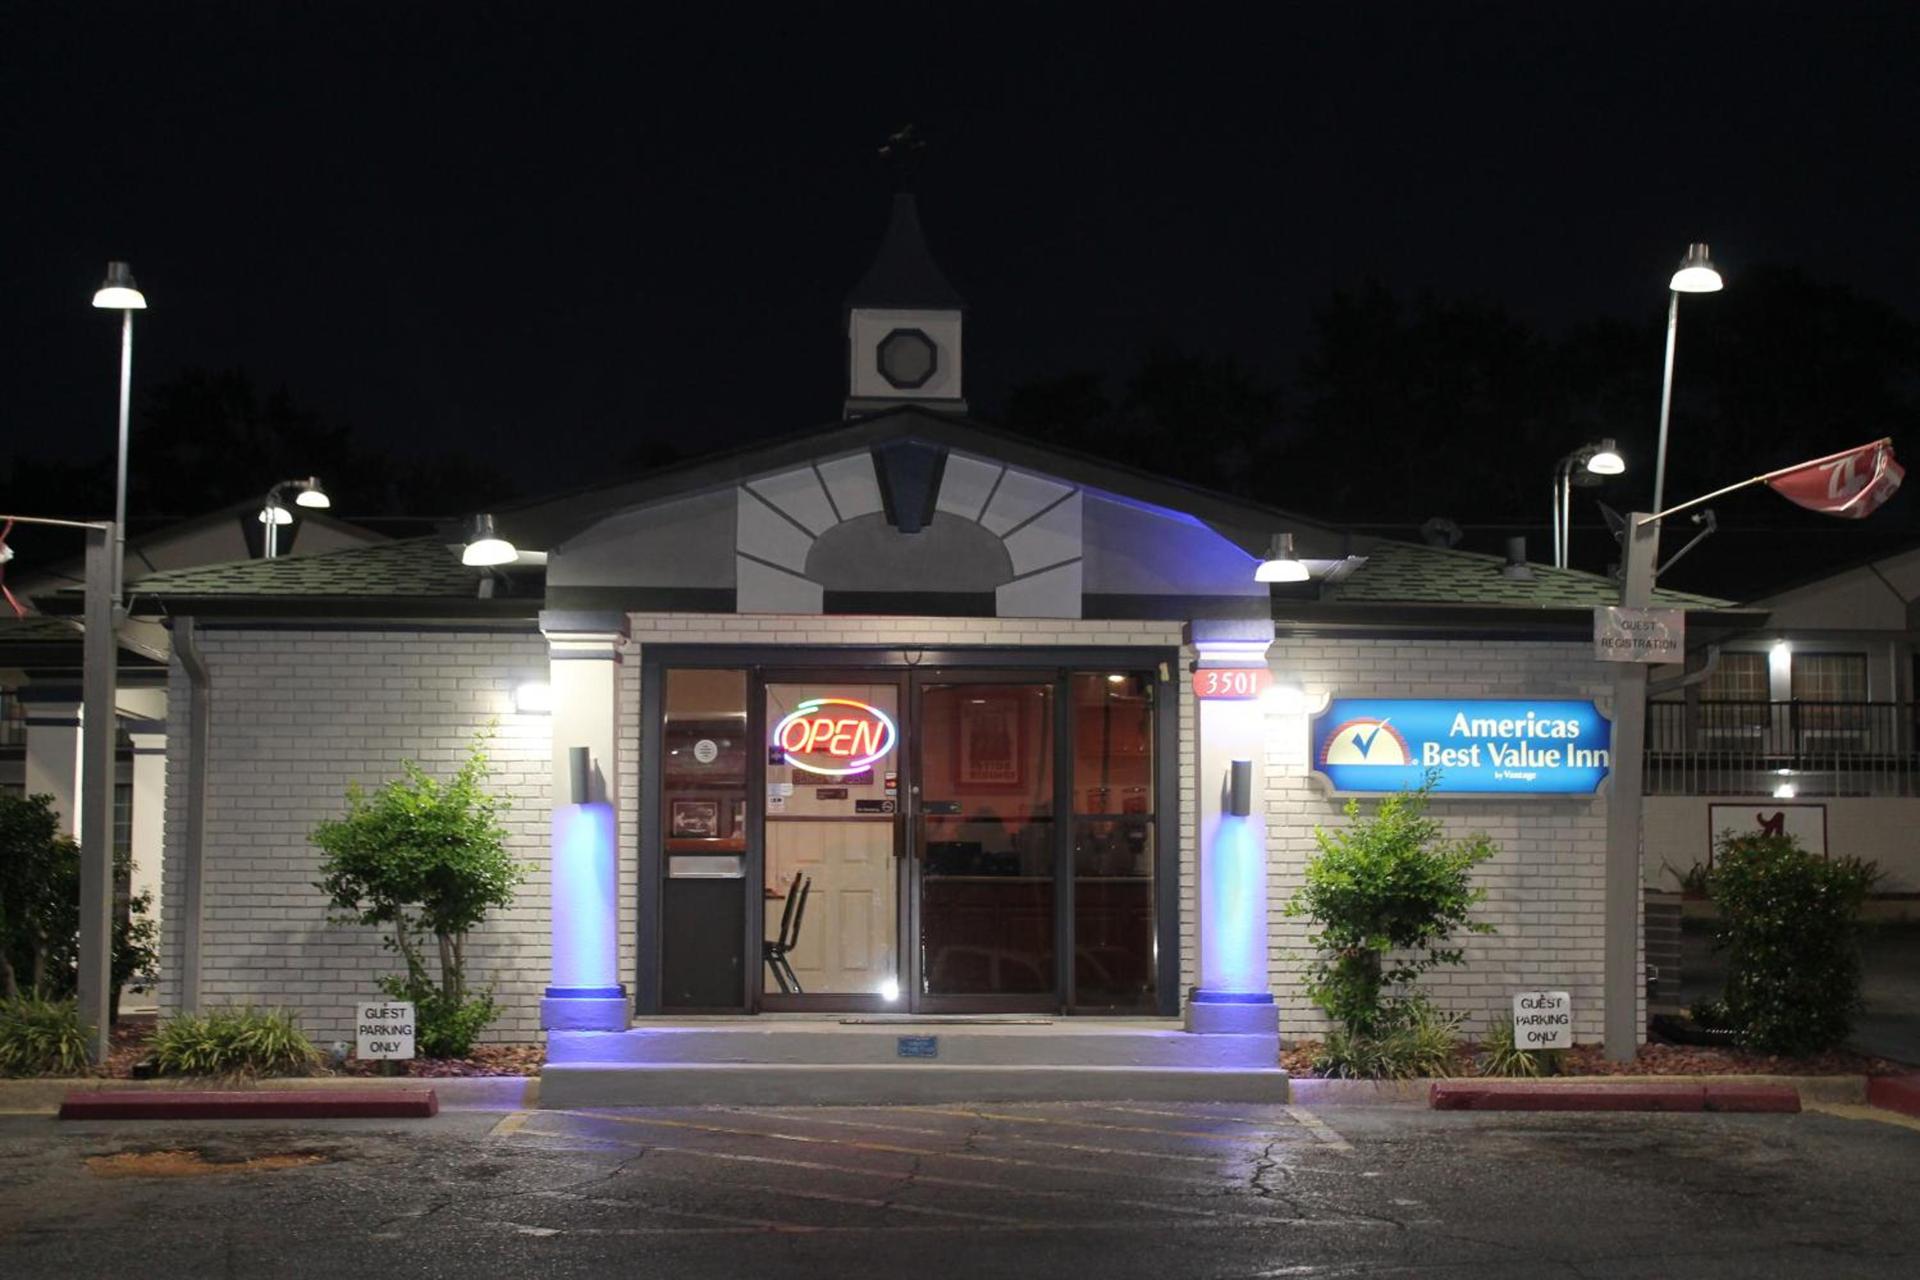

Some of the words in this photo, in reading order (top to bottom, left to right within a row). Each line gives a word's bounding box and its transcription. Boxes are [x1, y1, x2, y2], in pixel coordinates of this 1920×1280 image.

[1621, 620, 1656, 631] GUEST
[1601, 638, 1677, 650] REGISTRATION
[1206, 672, 1257, 694] 3501
[1450, 711, 1580, 738] Americas
[782, 717, 885, 756] OPEN
[1422, 742, 1481, 768] Best
[1487, 741, 1561, 768] Value
[1567, 743, 1609, 768] Inn
[1521, 998, 1562, 1009] GUEST
[365, 1008, 407, 1019] GUEST
[1516, 1014, 1569, 1025] PARKING
[359, 1024, 412, 1036] PARKING
[1527, 1031, 1558, 1042] ONLY
[370, 1041, 401, 1053] ONLY
